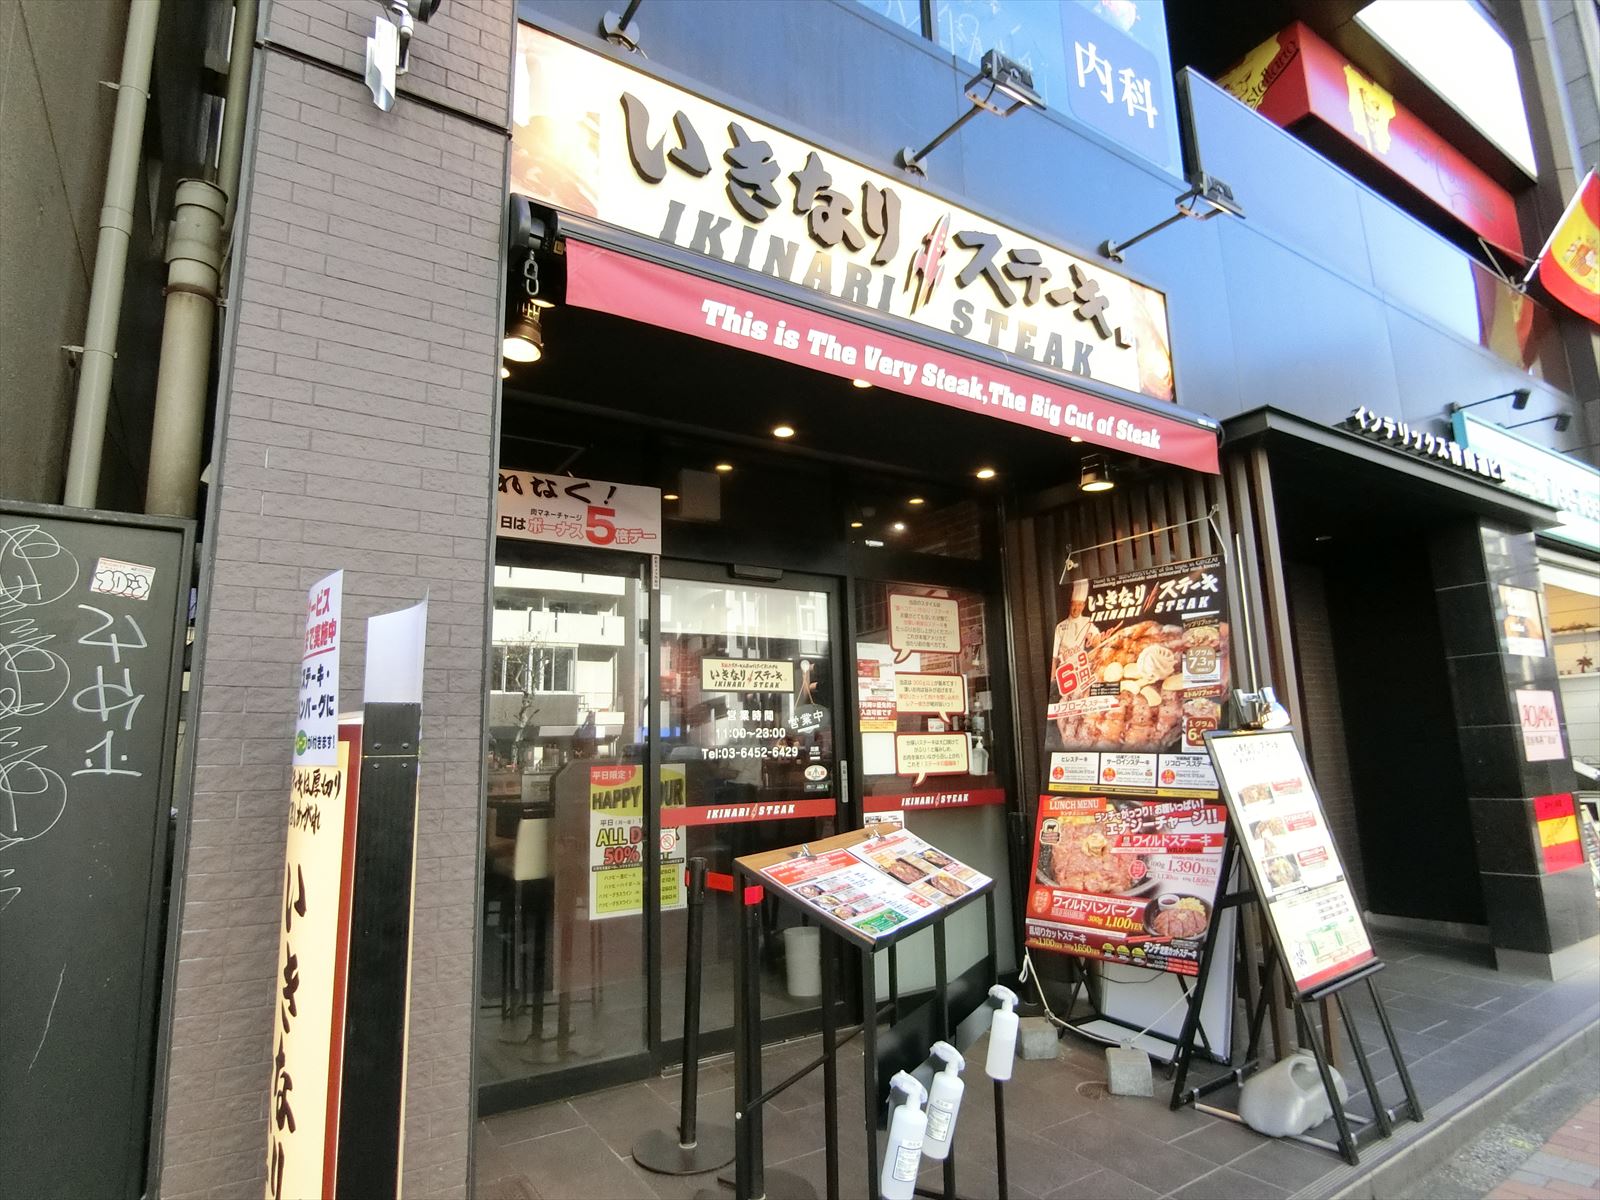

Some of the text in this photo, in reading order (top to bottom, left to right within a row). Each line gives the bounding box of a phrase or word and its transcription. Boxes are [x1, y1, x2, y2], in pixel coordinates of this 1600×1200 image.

[1074, 41, 1158, 128] 内科
[620, 91, 1112, 341] いきなり ステーキ
[659, 199, 1094, 377] IKINARI STEAK
[701, 298, 768, 350] This
[773, 320, 800, 351] is
[806, 329, 858, 367] The
[864, 346, 917, 386] Very
[1030, 392, 1061, 427] Big
[1064, 403, 1094, 433] Cut
[1096, 416, 1115, 437] of
[1115, 418, 1161, 450] Steak
[1088, 583, 1147, 612] いきなり
[1158, 572, 1218, 600] ステーキ
[1090, 595, 1210, 622] IKINARI STEAK
[1188, 656, 1215, 670] 7.3円
[710, 669, 783, 682] いきなり ステーキ
[714, 681, 780, 689] IKINARI STEAK
[726, 709, 774, 722] 営業時間
[788, 709, 824, 730] 営業中
[702, 745, 799, 760] Tel:03-6452-6429
[592, 770, 633, 781] 平日限定!
[592, 778, 684, 811] HAPPY UR
[901, 792, 969, 807] IKINARI STEAK
[1050, 799, 1100, 810] LUNCH MENU
[706, 803, 796, 820] IKINARI STEAK
[596, 827, 627, 847] ALL
[1132, 834, 1212, 847] ワイルドステーキ
[603, 845, 640, 867] 50%
[1053, 896, 1138, 918] ワイルドハンバーグ
[268, 862, 307, 1200] いきなり
